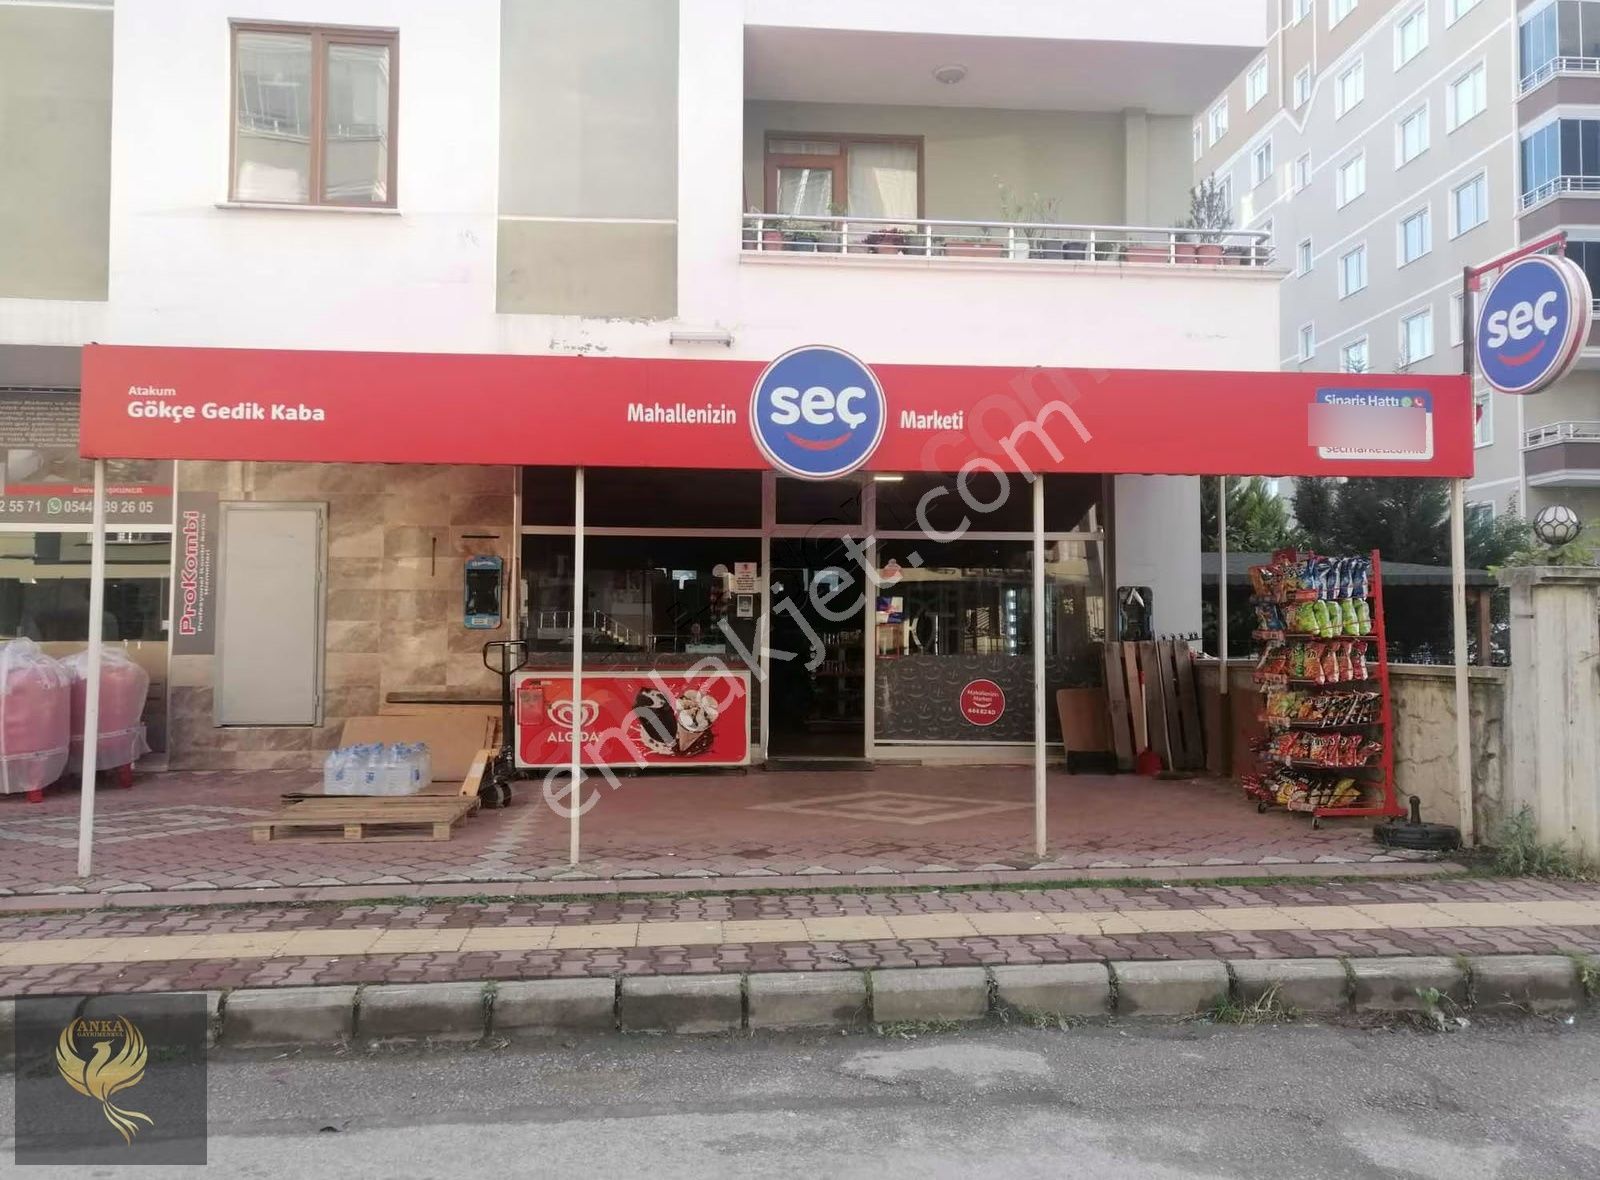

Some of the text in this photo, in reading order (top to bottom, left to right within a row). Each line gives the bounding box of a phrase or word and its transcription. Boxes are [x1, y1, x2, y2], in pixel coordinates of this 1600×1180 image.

[1487, 291, 1557, 348] seç
[128, 385, 176, 396] Atakum
[127, 400, 325, 423] Gökçe Gedik Kaba
[627, 403, 964, 430] Mahallenizin Marketi
[770, 386, 867, 429] seç
[9, 500, 24, 513] 55
[27, 500, 40, 512] 71
[64, 501, 92, 513] 0544
[121, 501, 136, 514] 26
[139, 501, 153, 514] 05
[179, 511, 199, 635] ProKombi
[547, 732, 600, 743] ALGDA
